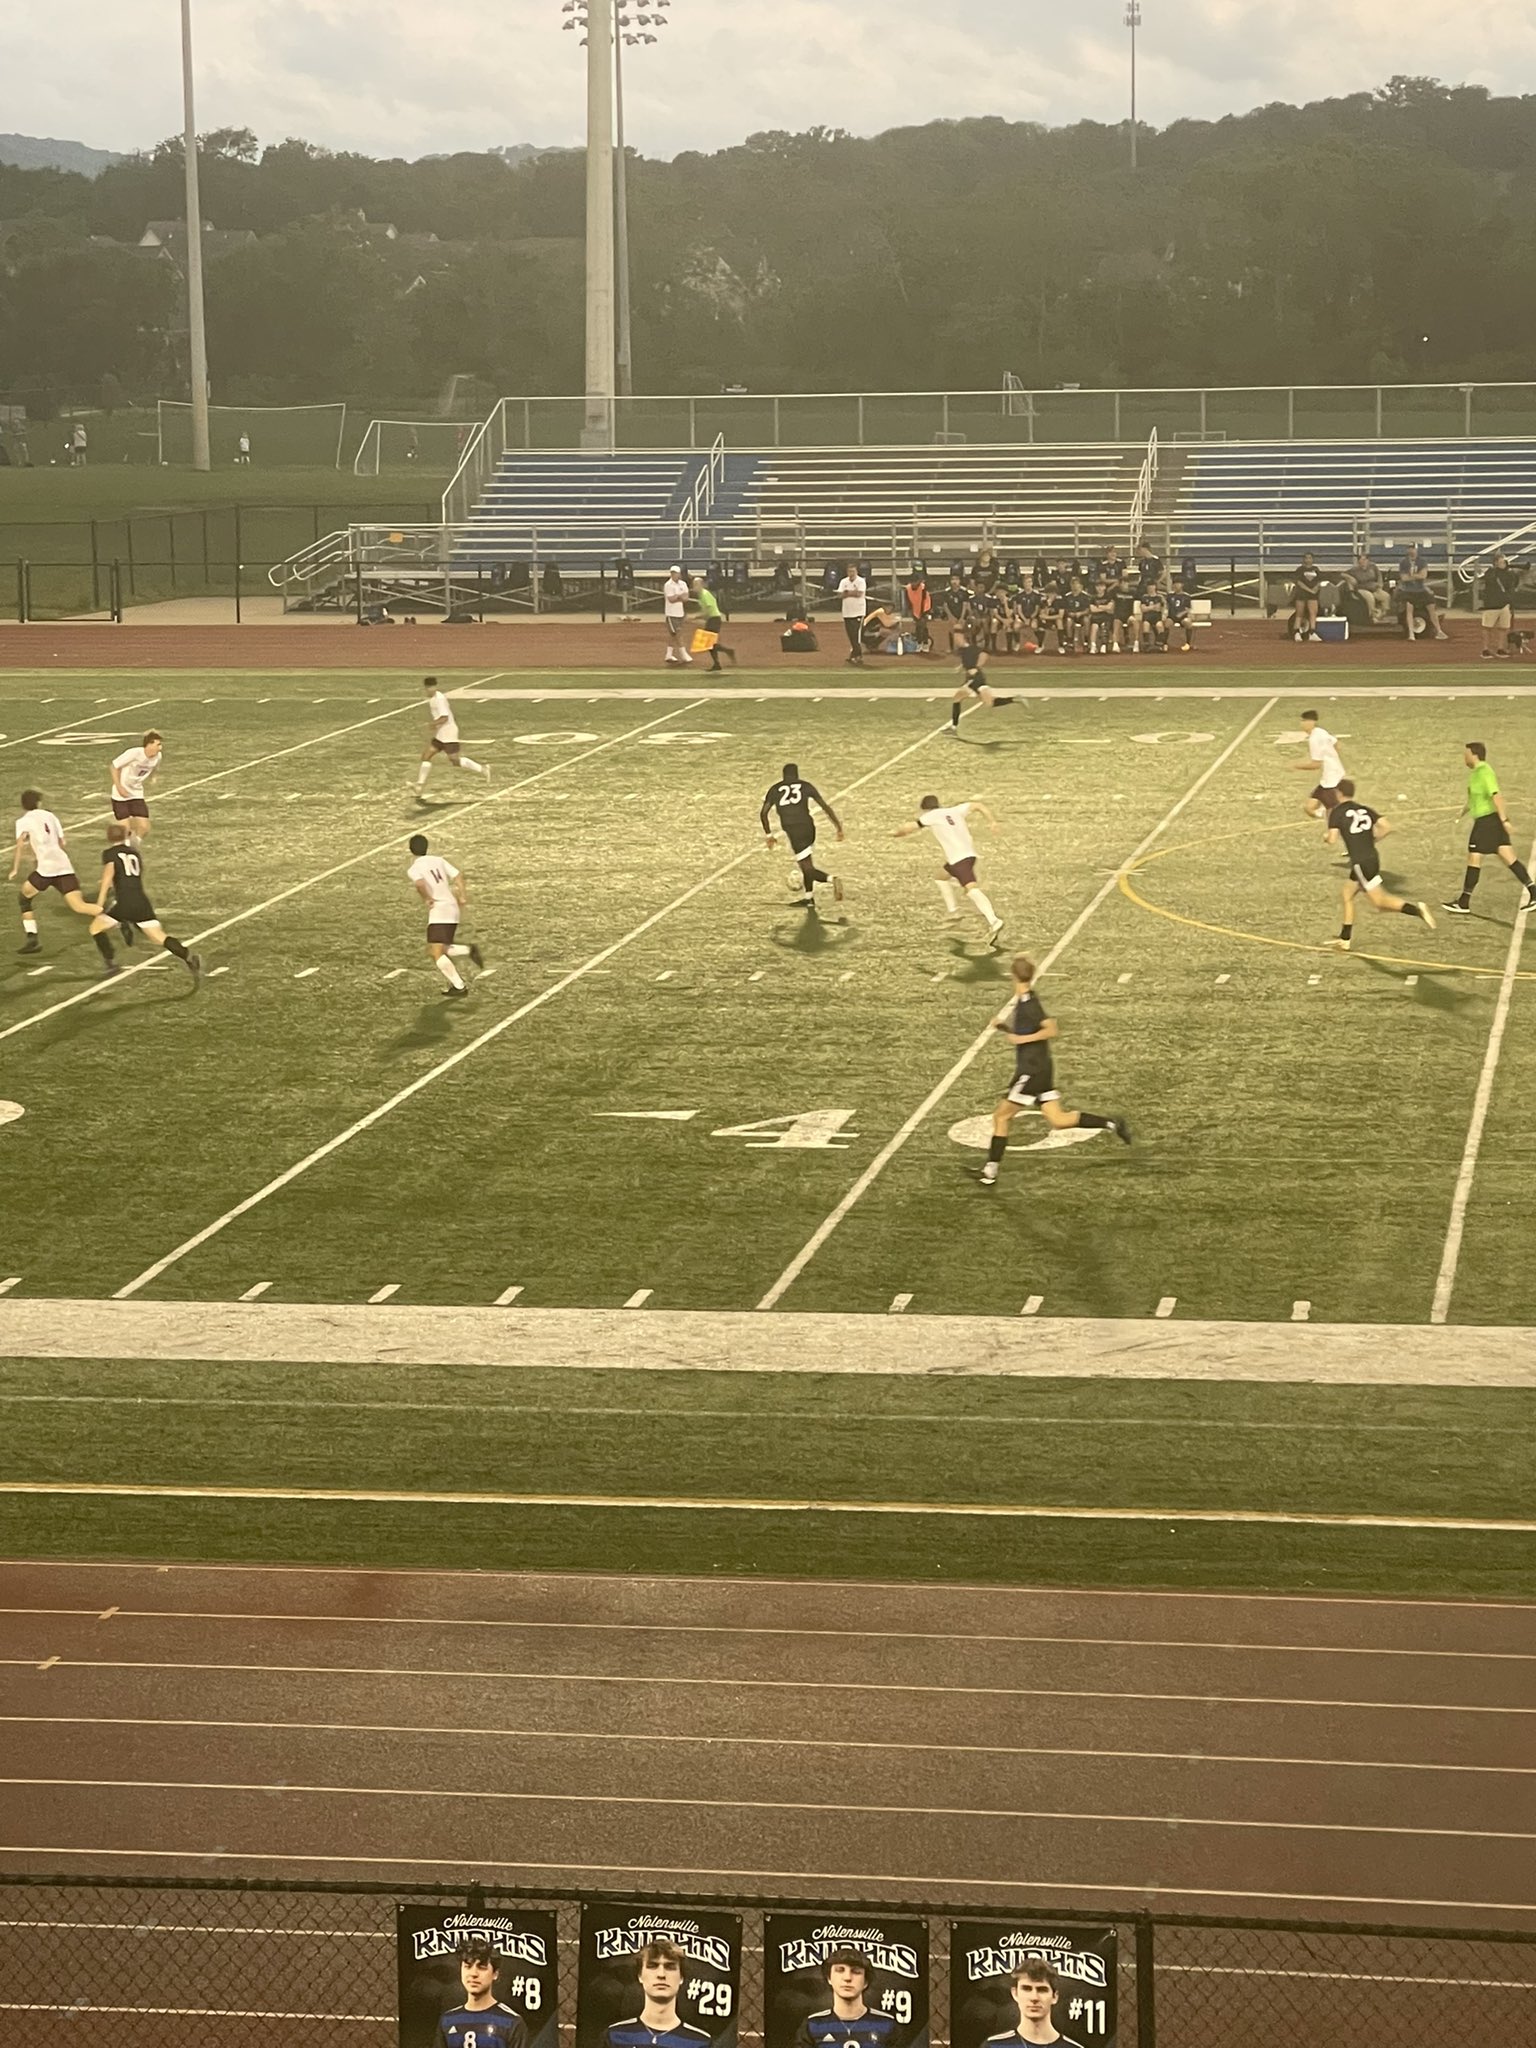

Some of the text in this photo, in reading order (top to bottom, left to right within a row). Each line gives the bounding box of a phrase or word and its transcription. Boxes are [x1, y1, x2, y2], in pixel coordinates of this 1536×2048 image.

[778, 783, 802, 806] 23
[1345, 808, 1373, 834] 25
[117, 852, 140, 877] 10
[443, 1913, 513, 1931] Nolensville
[627, 1914, 700, 1934] Nolensville
[812, 1924, 884, 1942] Nolensville
[998, 1931, 1072, 1950] Nolensville
[511, 1976, 541, 2010] #8
[687, 1978, 732, 2018] #29
[881, 1988, 912, 2024] #9
[1069, 1998, 1106, 2034] #11
